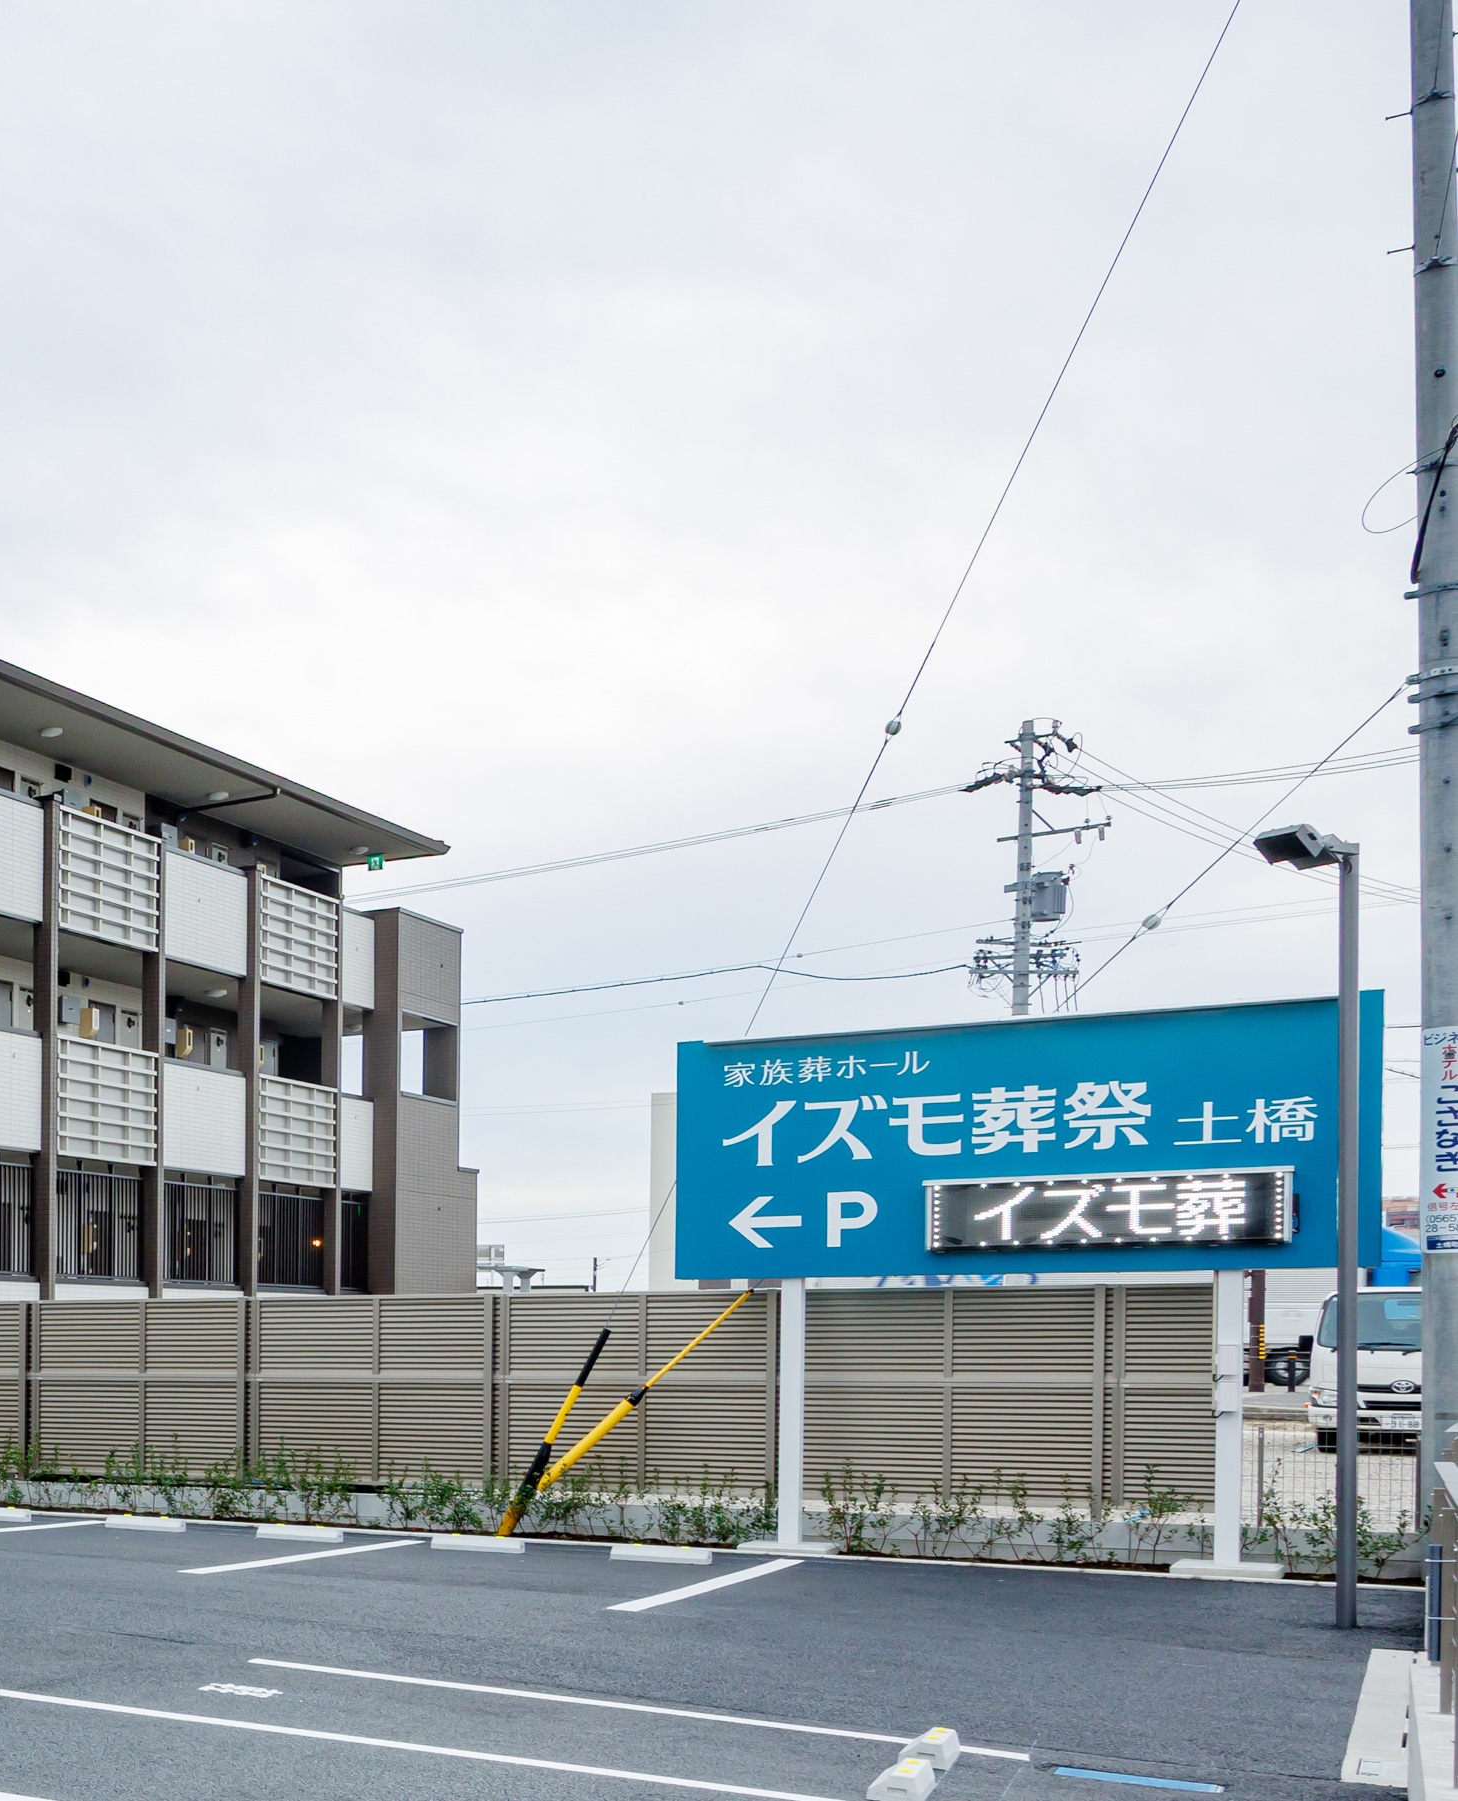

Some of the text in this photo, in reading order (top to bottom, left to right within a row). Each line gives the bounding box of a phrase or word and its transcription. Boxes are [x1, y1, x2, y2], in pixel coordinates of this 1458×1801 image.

[723, 1051, 931, 1088] 家族葬ホール
[722, 1081, 1318, 1166] イズモ葬祭 土橋
[827, 1191, 878, 1248] P
[974, 1180, 1246, 1240] イズモ葬
